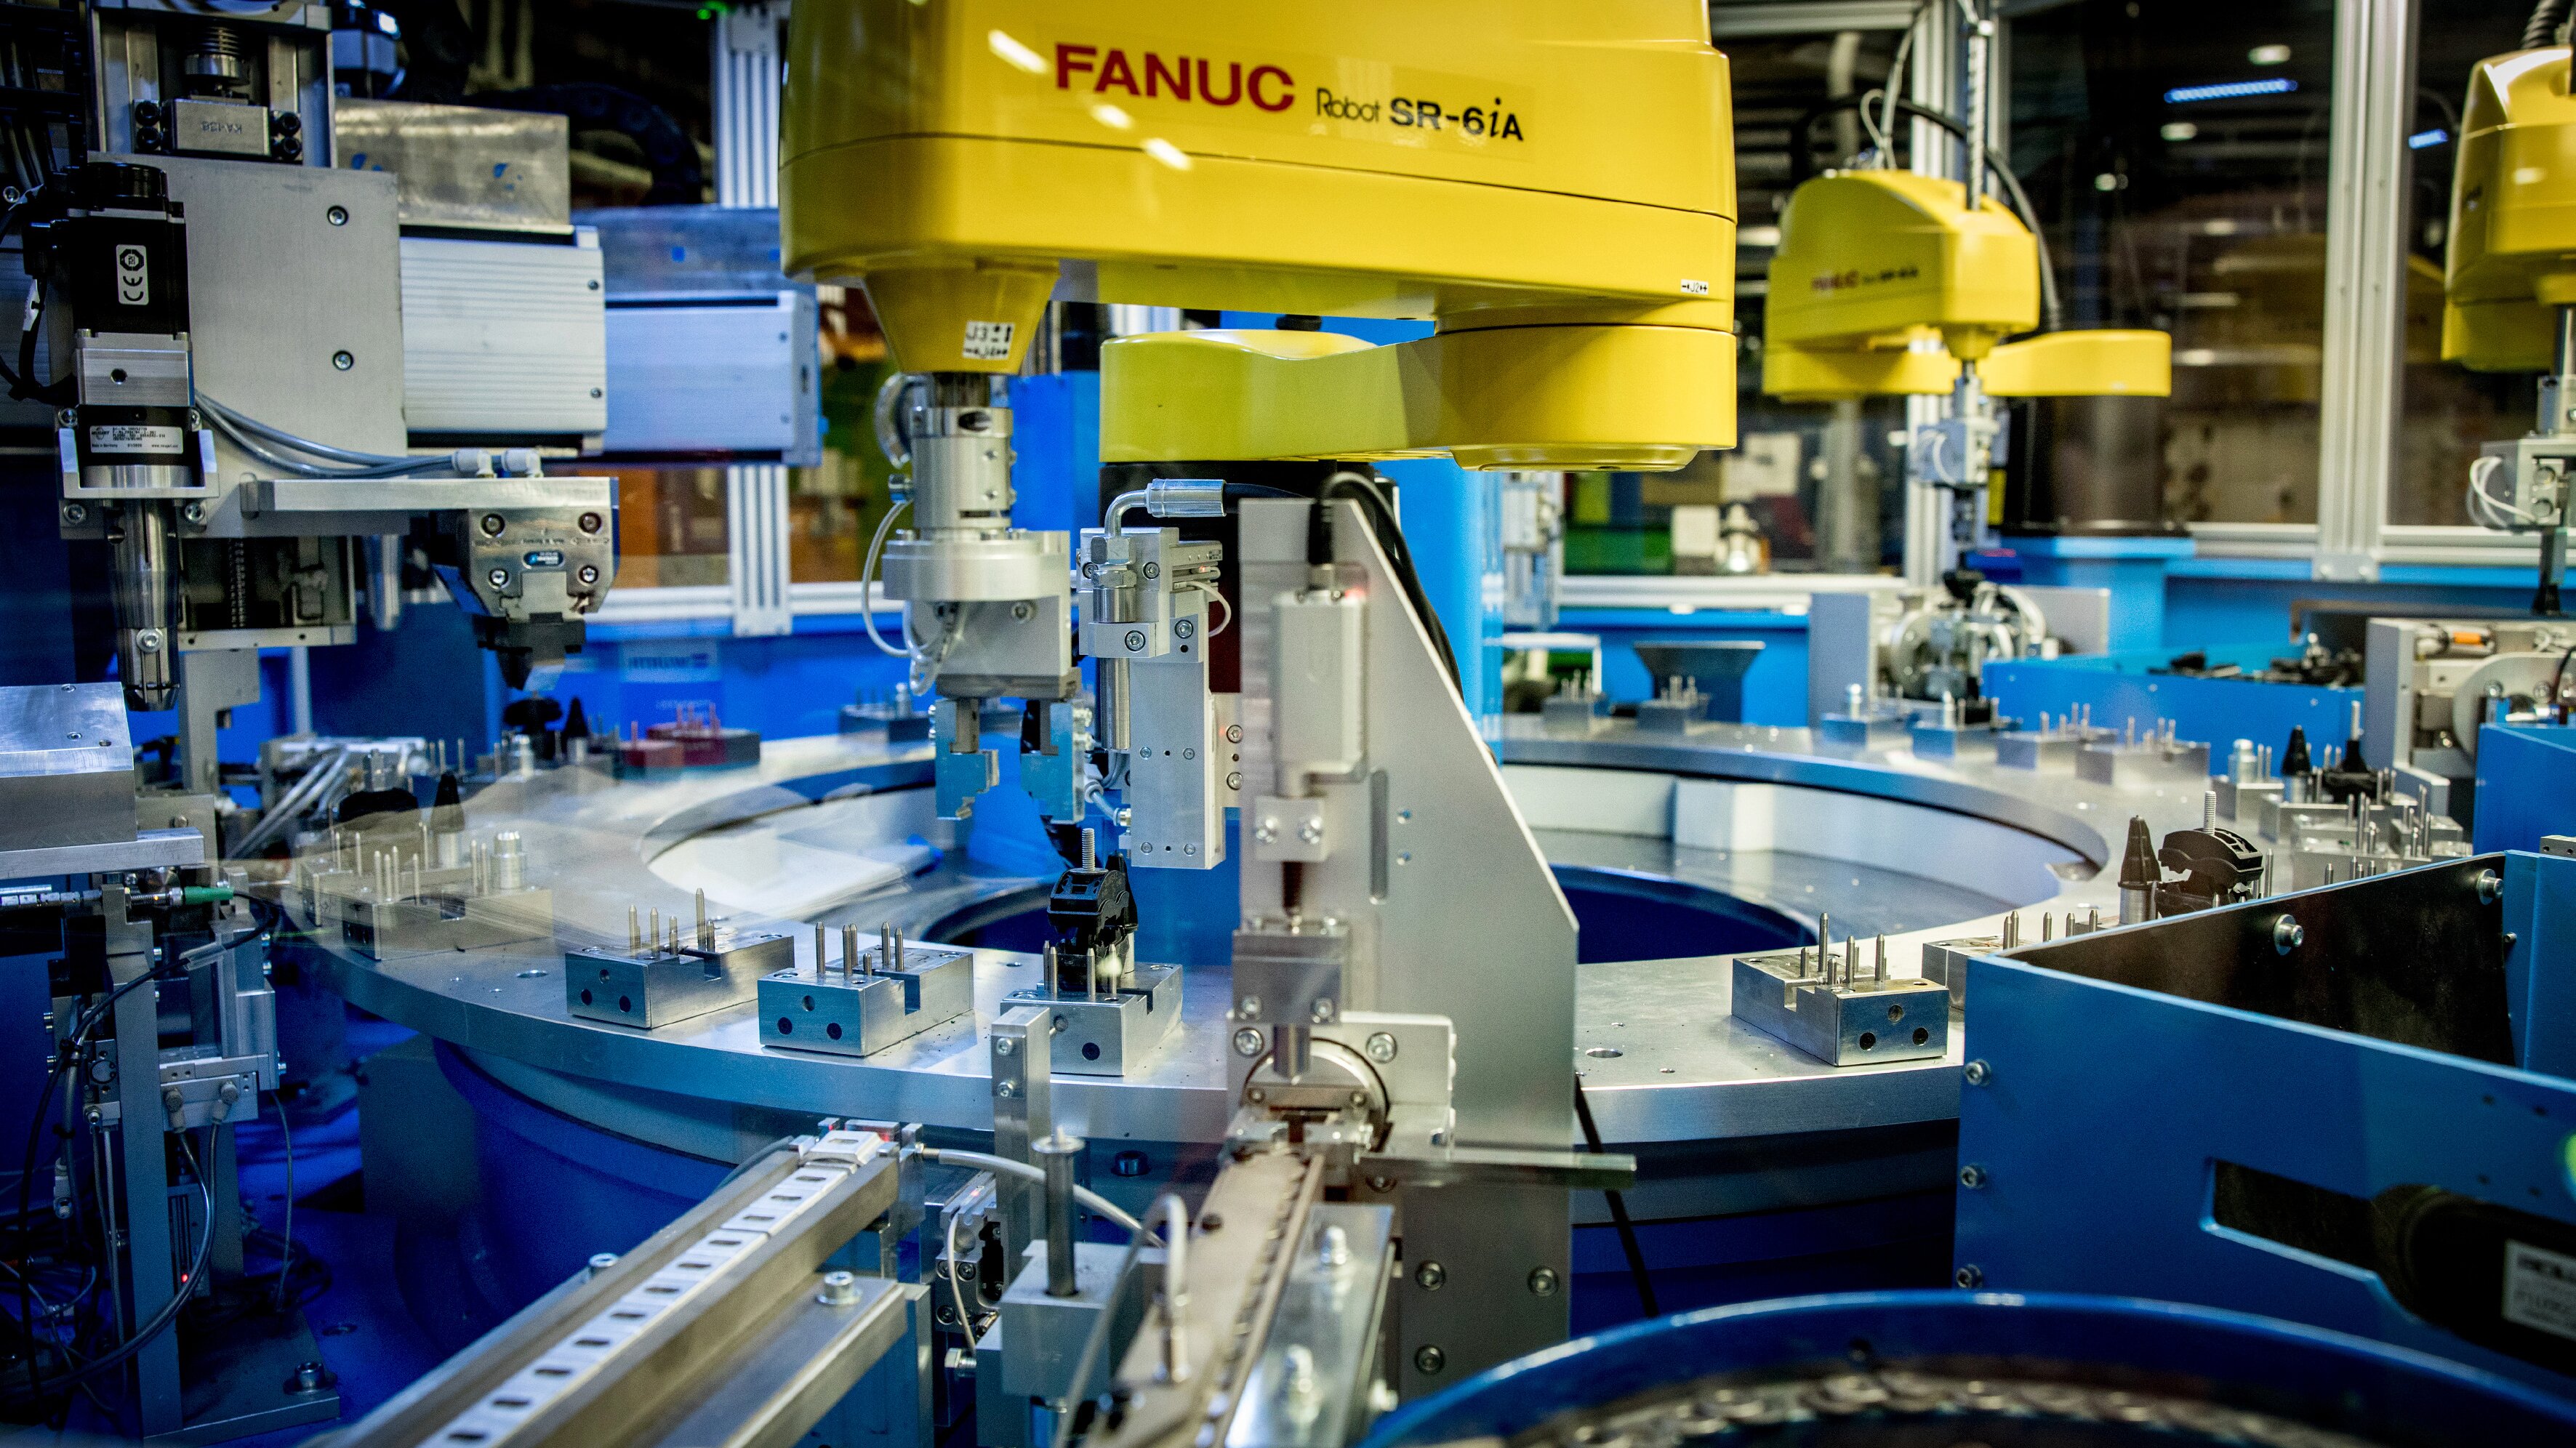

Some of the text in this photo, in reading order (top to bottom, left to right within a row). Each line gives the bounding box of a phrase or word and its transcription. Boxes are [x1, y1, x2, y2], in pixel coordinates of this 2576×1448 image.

[1056, 42, 1294, 112] FANUC
[1317, 87, 1380, 122] Robot
[123, 275, 144, 302] CE
